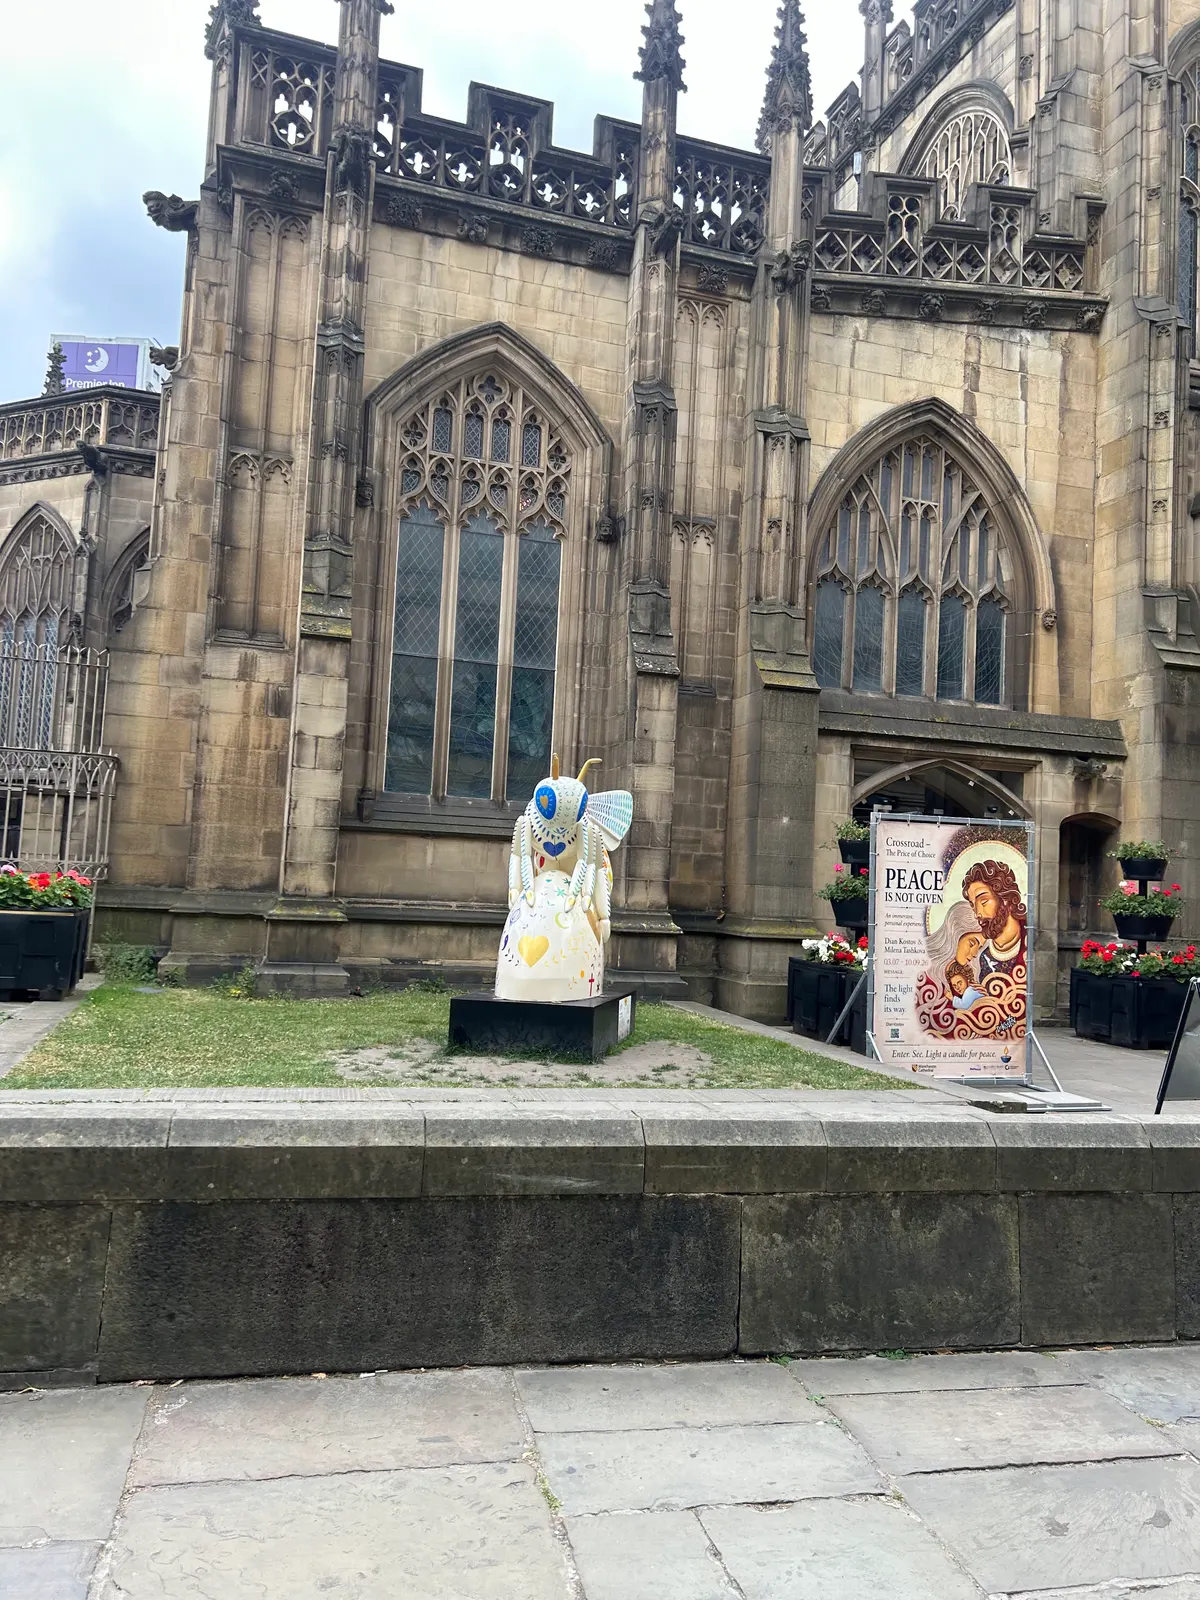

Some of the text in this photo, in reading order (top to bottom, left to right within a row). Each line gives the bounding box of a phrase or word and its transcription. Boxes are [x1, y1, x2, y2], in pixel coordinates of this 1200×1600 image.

[886, 836, 924, 848] Crossroad
[886, 849, 896, 857] The
[885, 868, 944, 891] PEACE
[885, 892, 944, 904] IS NOT GIVEN
[885, 937, 898, 945] Dian
[884, 984, 912, 995] The light
[884, 994, 900, 1002] finds
[892, 1050, 910, 1058] Enter.
[912, 1050, 924, 1058] See.
[926, 1050, 942, 1060] Light
[948, 1050, 968, 1058] candle
[968, 1048, 978, 1060] for
[979, 1052, 996, 1060] peace.
